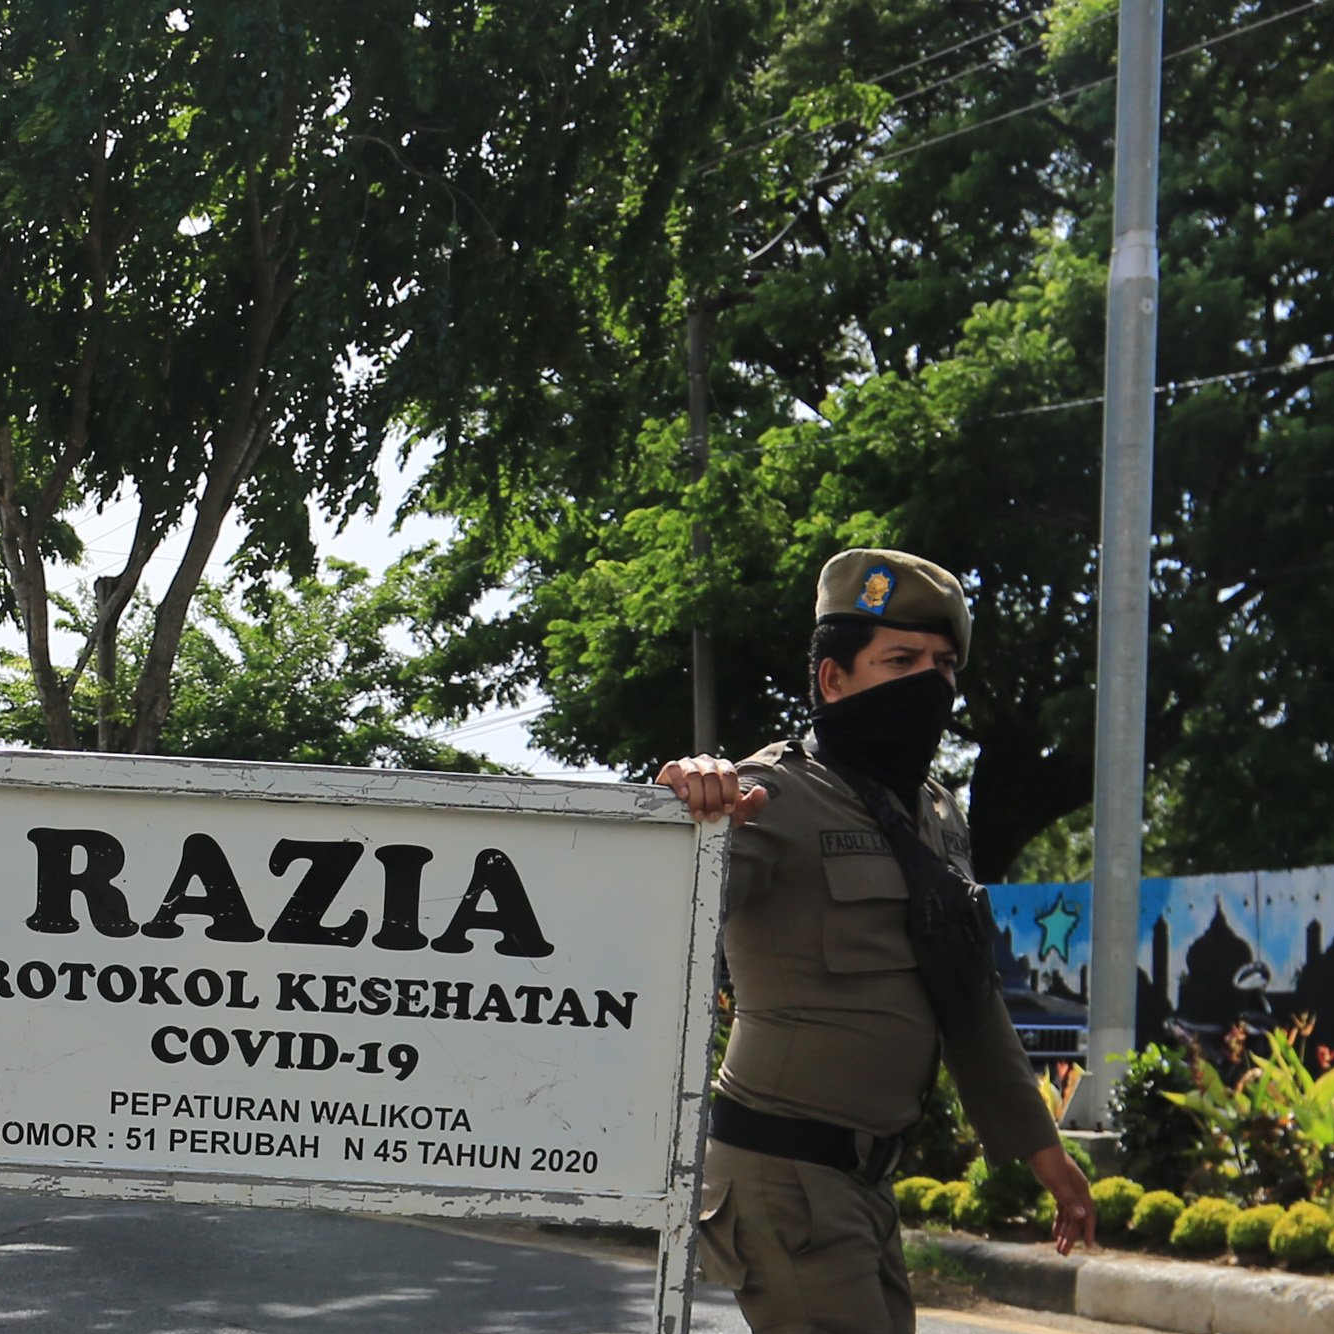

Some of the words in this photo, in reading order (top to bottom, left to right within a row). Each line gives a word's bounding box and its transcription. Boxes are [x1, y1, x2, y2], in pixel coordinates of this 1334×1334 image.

[26, 827, 555, 958] RAZIA
[276, 973, 638, 1029] KESEHATAN
[151, 1026, 419, 1082] COVID-19
[110, 1091, 300, 1122] PEPATURAN
[310, 1100, 472, 1132] WALIKOTA
[125, 1128, 156, 1151] 51
[169, 1128, 320, 1158] PERUBAH
[344, 1136, 364, 1160] N
[374, 1139, 408, 1163] 45
[417, 1141, 521, 1169] TAHUN
[531, 1147, 598, 1174] 2020
